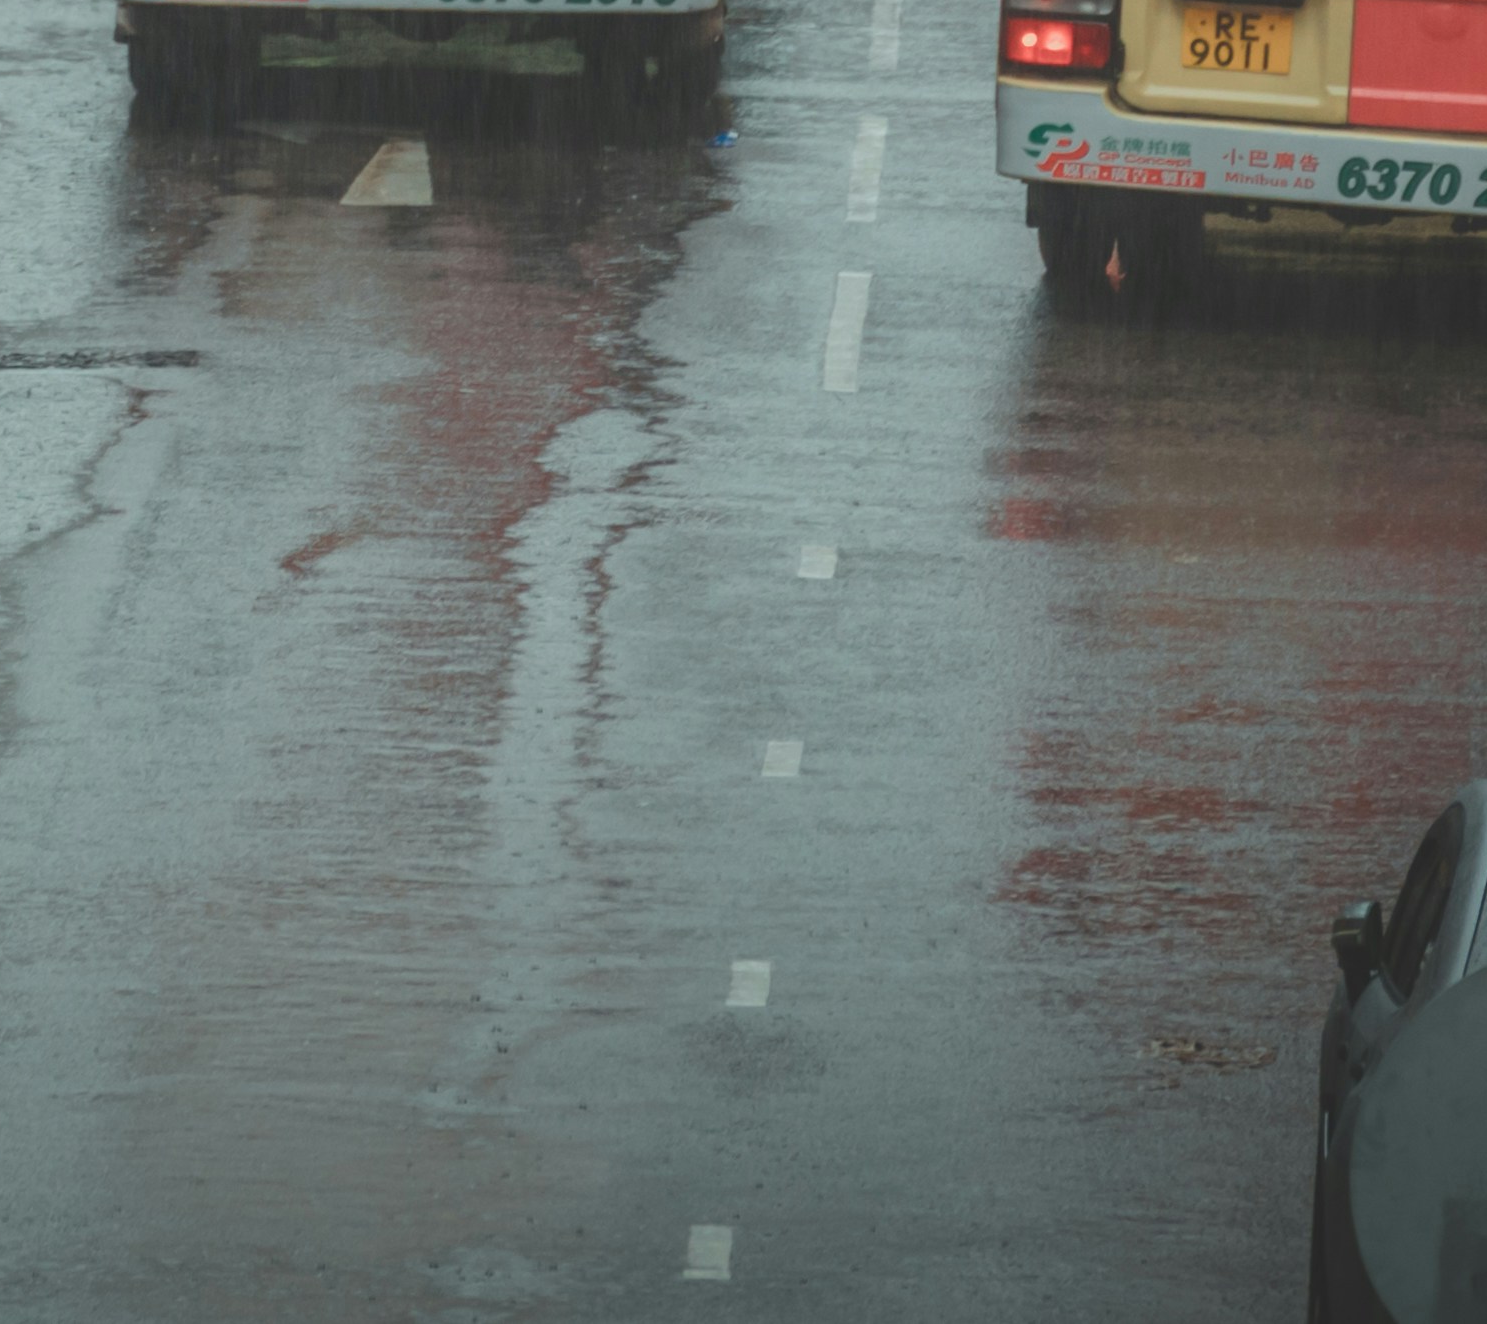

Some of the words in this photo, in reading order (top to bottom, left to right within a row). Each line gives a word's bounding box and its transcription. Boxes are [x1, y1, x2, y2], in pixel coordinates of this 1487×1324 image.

[1215, 12, 1261, 43] RE
[1189, 38, 1271, 71] 9011
[1223, 147, 1321, 174] 小巴廣告
[1225, 170, 1288, 189] Minibus
[1293, 177, 1315, 190] AD
[1337, 156, 1462, 205] 6370
